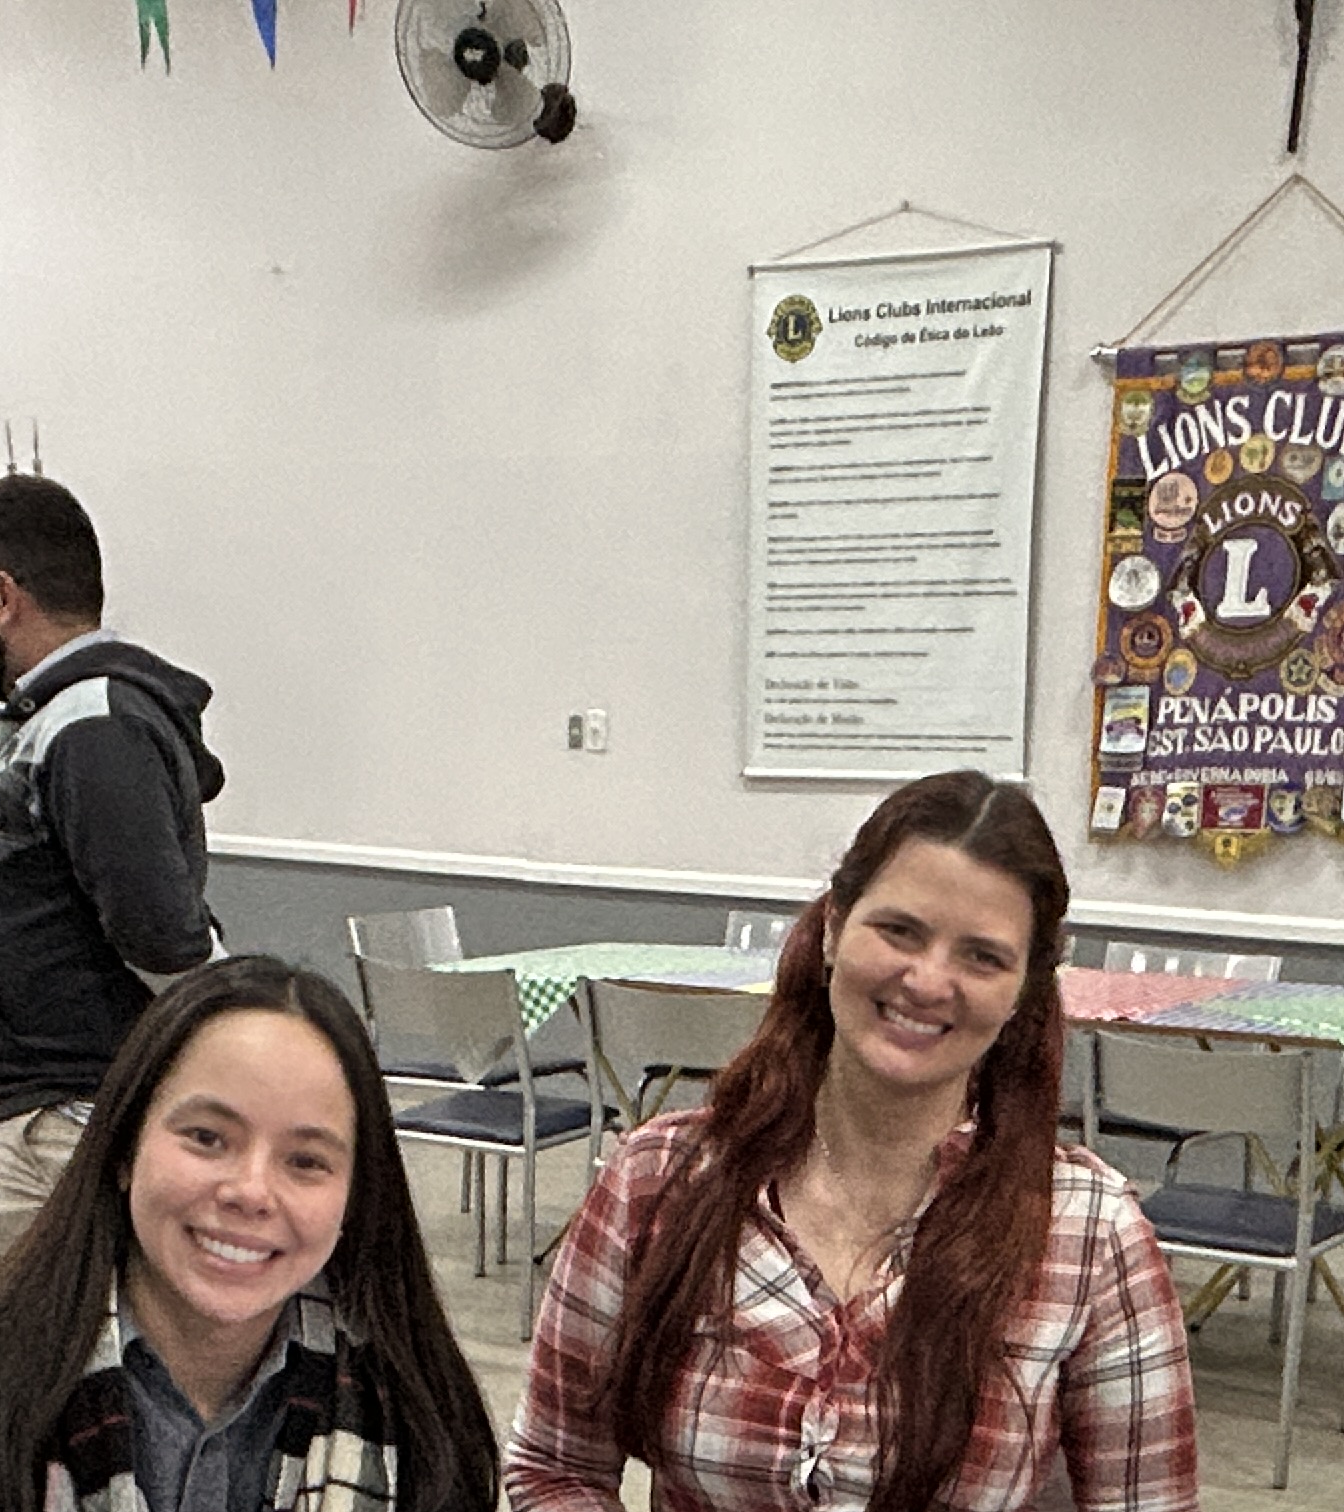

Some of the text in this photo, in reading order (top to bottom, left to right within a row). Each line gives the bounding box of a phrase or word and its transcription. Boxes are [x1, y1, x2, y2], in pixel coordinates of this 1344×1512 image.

[828, 290, 1032, 324] Lions Clubs Internacional
[1137, 395, 1252, 482] LIONS
[1203, 490, 1302, 534] LIONS
[1216, 538, 1272, 618] L
[1157, 687, 1338, 724] PENÁPOLIS
[1253, 726, 1344, 755] PAULO
